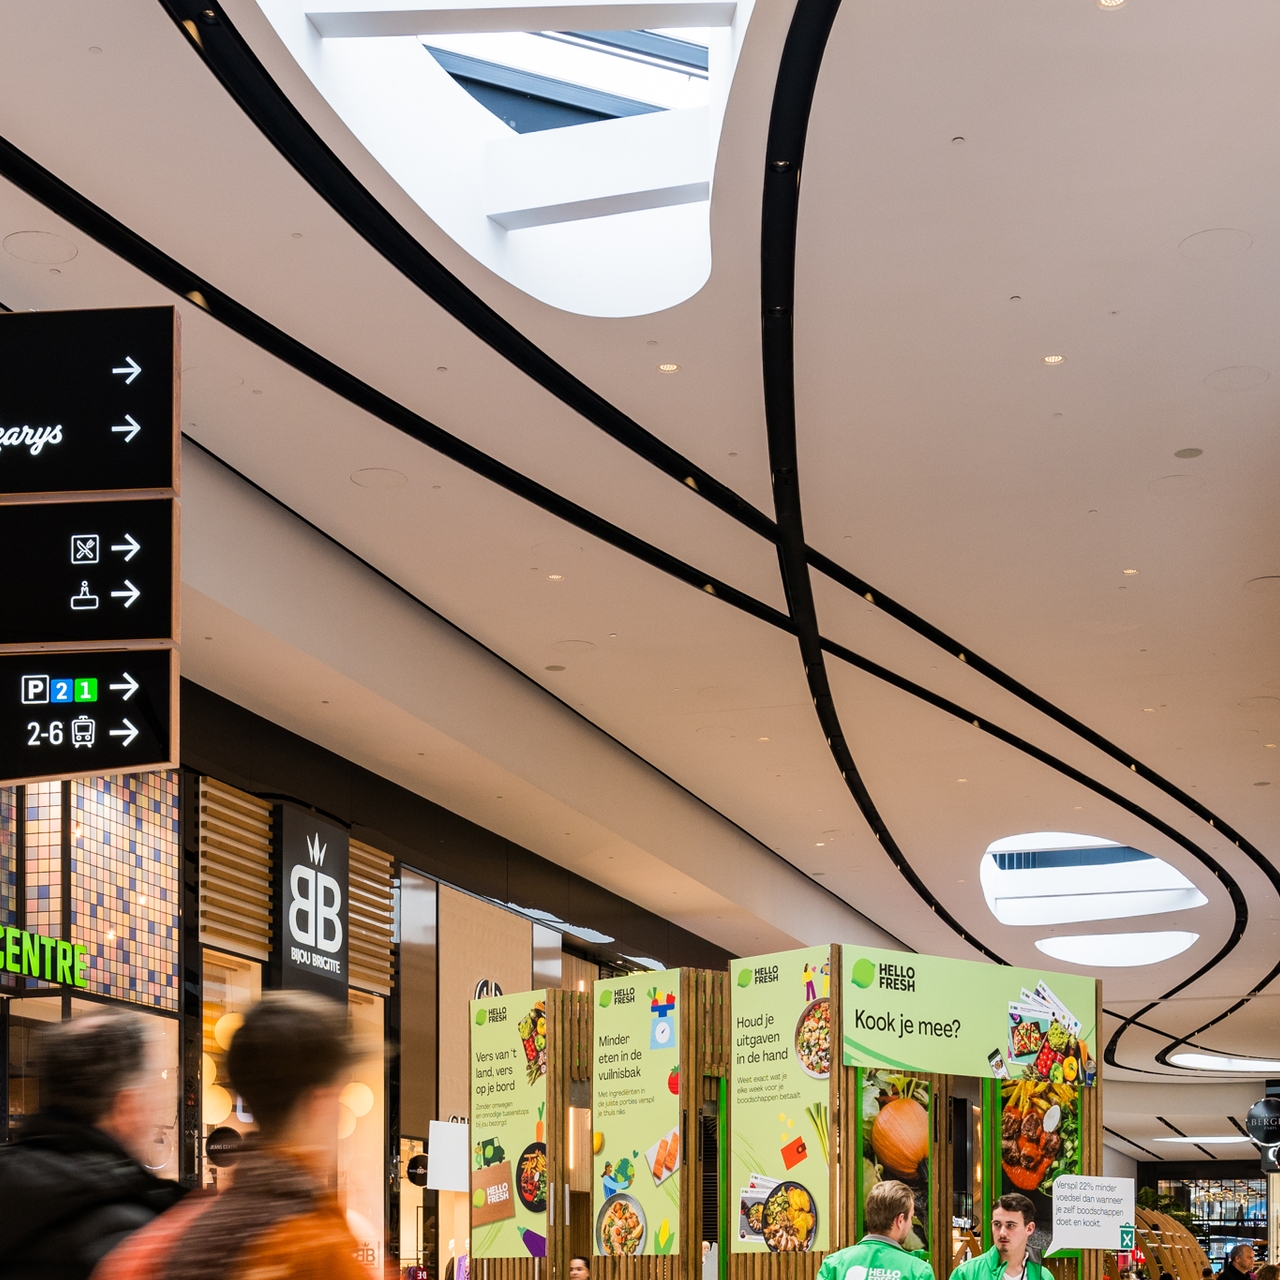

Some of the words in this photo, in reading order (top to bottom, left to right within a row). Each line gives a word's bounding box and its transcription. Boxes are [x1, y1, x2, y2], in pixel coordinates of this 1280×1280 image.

[56, 682, 68, 700] 2
[81, 682, 91, 700] 1
[27, 722, 64, 746] 2-6
[291, 946, 311, 965] BIJOU
[312, 953, 341, 974] BRIGITTE
[754, 965, 778, 976] HELLO
[879, 963, 915, 979] HELLO
[754, 974, 778, 985] FRESH
[879, 976, 915, 992] FRESH
[614, 987, 635, 997] HELLO
[614, 995, 635, 1005] FRESH
[488, 1006, 507, 1016] HELLO
[488, 1014, 507, 1023] FRESH
[736, 1014, 763, 1029] Houd
[764, 1013, 774, 1028] je
[855, 1009, 896, 1032] Kook
[898, 1013, 914, 1038] je
[918, 1019, 961, 1038] mee?
[598, 1033, 630, 1047] Minder
[736, 1033, 780, 1048] uitgaven
[476, 1051, 493, 1062] Vers
[495, 1051, 509, 1060] van
[598, 1053, 619, 1064] eten
[620, 1051, 628, 1061] in
[630, 1049, 642, 1060] de
[736, 1053, 745, 1064] in
[747, 1051, 760, 1063] de
[762, 1048, 788, 1062] hand
[476, 1066, 494, 1078] land,
[495, 1066, 513, 1076] vers
[598, 1066, 641, 1081] vuilnisbak
[737, 1075, 753, 1084] Weet
[753, 1074, 769, 1082] exact
[476, 1085, 486, 1096] op
[487, 1083, 495, 1096] je
[496, 1080, 515, 1092] bord
[598, 1090, 608, 1098] Met
[737, 1086, 748, 1094] elke
[749, 1085, 763, 1093] week
[737, 1094, 778, 1104] boodschappen
[780, 1091, 801, 1100] betaalt
[486, 1182, 509, 1196] HELLO
[1056, 1181, 1078, 1191] Verspil
[1079, 1182, 1094, 1190] 22%
[1095, 1183, 1117, 1192] minder
[487, 1191, 510, 1205] FRESH
[1056, 1193, 1081, 1202] voedsel
[1082, 1194, 1095, 1203] dan
[1055, 1205, 1062, 1215] je
[1063, 1205, 1075, 1214] zelf
[1077, 1206, 1124, 1217] boodschappen
[1056, 1217, 1071, 1226] doet
[868, 1268, 901, 1278] HELLO
